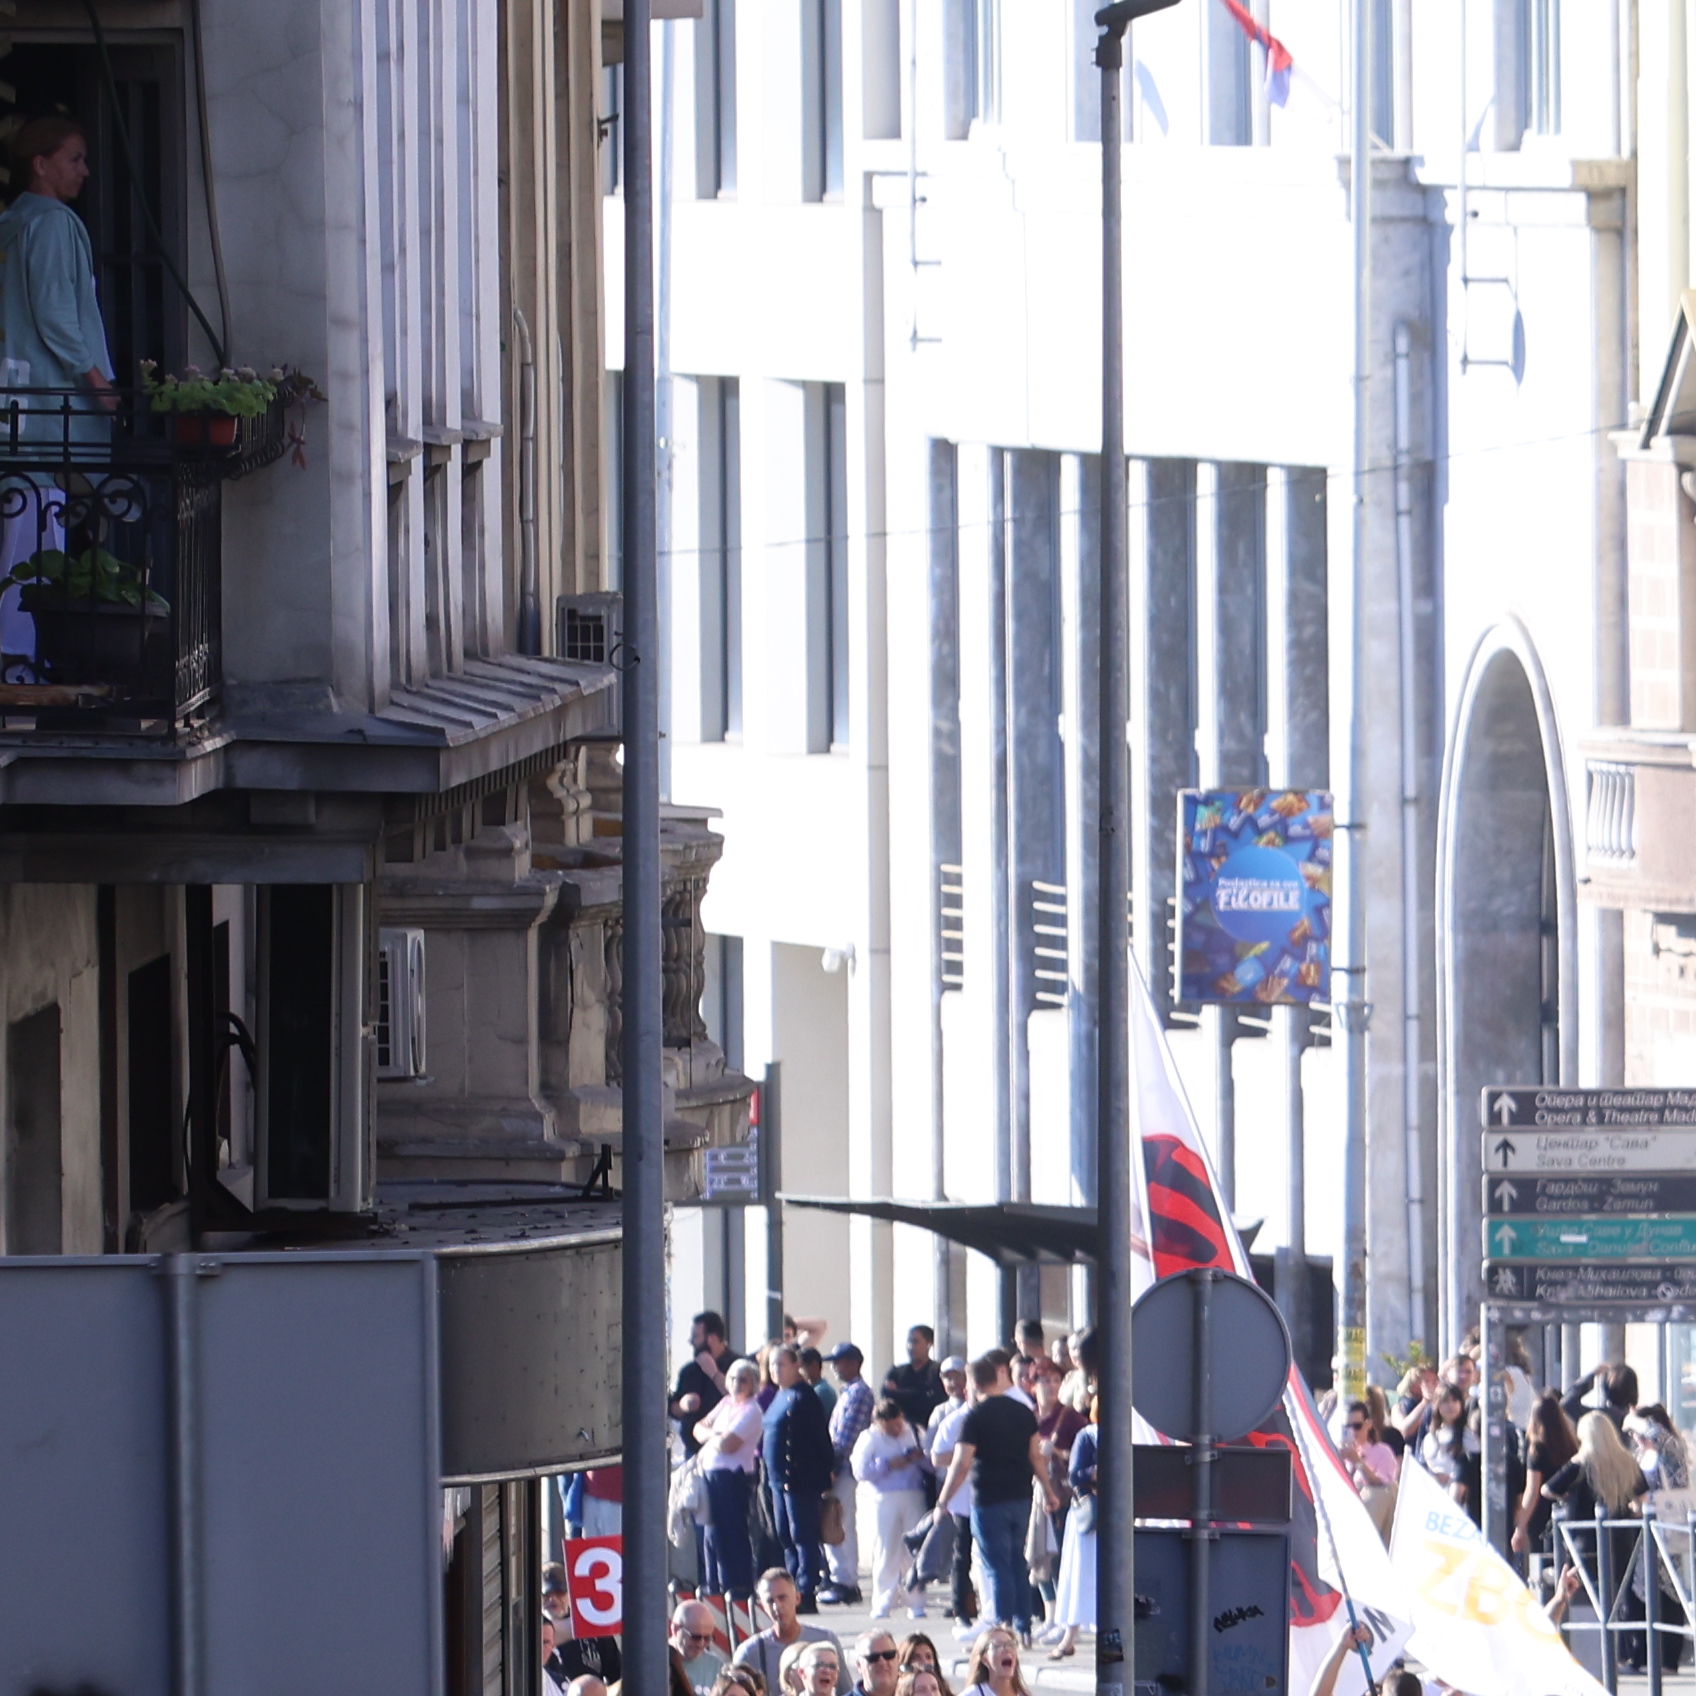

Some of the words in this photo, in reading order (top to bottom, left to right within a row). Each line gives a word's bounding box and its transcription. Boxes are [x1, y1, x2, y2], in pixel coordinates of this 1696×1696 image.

[1535, 1110, 1584, 1127] Opera
[1587, 1110, 1598, 1124] &
[1602, 1110, 1659, 1124] Theatre
[1536, 1154, 1574, 1168] Sava
[1576, 1153, 1627, 1168] Centre
[1602, 1197, 1655, 1212] Zemun
[573, 1547, 623, 1628] 3
